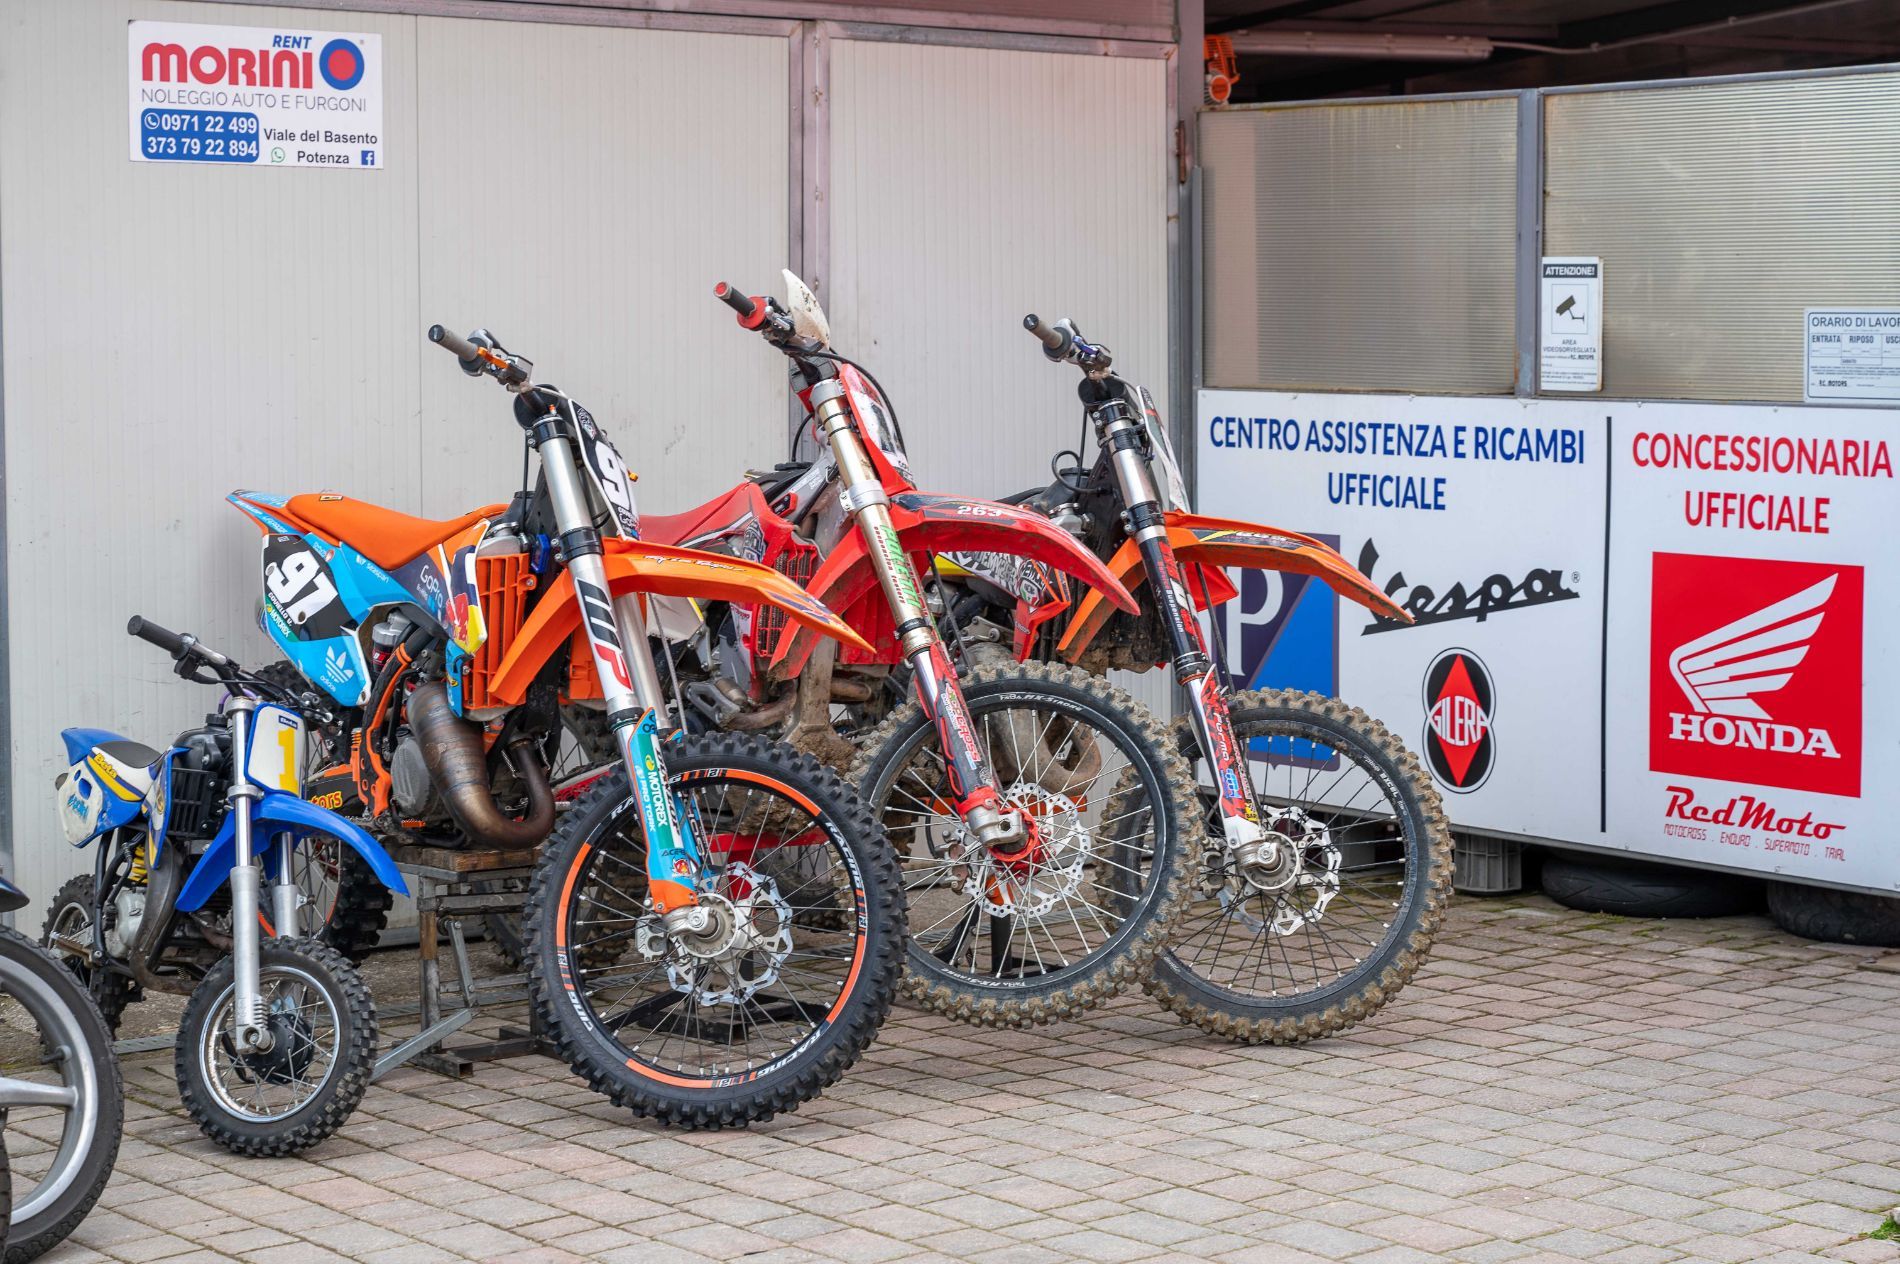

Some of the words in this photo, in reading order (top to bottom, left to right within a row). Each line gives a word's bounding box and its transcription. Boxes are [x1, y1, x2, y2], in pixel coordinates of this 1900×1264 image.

[272, 35, 312, 49] RENT
[141, 88, 228, 106] NOLEGGIO
[232, 92, 276, 108] AUTO
[281, 94, 290, 109] E
[295, 95, 366, 112] FURGONI
[161, 113, 199, 131] 0971
[205, 115, 224, 133] 22
[228, 117, 258, 134] 499
[264, 128, 296, 142] Viale
[300, 129, 320, 143] del
[324, 130, 378, 144] Basento
[147, 137, 177, 154] 373
[181, 138, 201, 155] 79
[205, 139, 224, 156] 22
[229, 140, 258, 157] 894
[297, 151, 350, 164] Potenza
[1545, 266, 1595, 276] ATTENZIONE!
[1811, 317, 1853, 327] ORARIO
[1855, 317, 1866, 327] DI
[1812, 335, 1841, 343] ENTRATA
[1849, 335, 1874, 344] RIPOSO
[1210, 416, 1300, 451] CENTRO
[1304, 420, 1447, 458] ASSISTENZA
[1454, 426, 1466, 459] E
[1474, 427, 1584, 465] RICAMBI
[1632, 432, 1894, 478] CONCESSIONARIA
[1327, 472, 1446, 511] UFFICIALE
[1684, 490, 1830, 534] UFFICIALE
[265, 549, 339, 625] 97
[1358, 537, 1580, 636] Vespa
[1428, 695, 1489, 747] GILERA
[1668, 712, 1841, 759] HONDA
[93, 753, 118, 779] Beta
[278, 727, 298, 797] 1
[639, 777, 650, 804] PRO
[647, 771, 669, 827] MOTOREX
[1665, 785, 1847, 840] RedMoto
[1663, 823, 1707, 841] MOTOCROSS
[1719, 832, 1751, 847] ENDURO
[1764, 838, 1810, 856] SUPERMOTO
[1825, 846, 1846, 861] TRIAL
